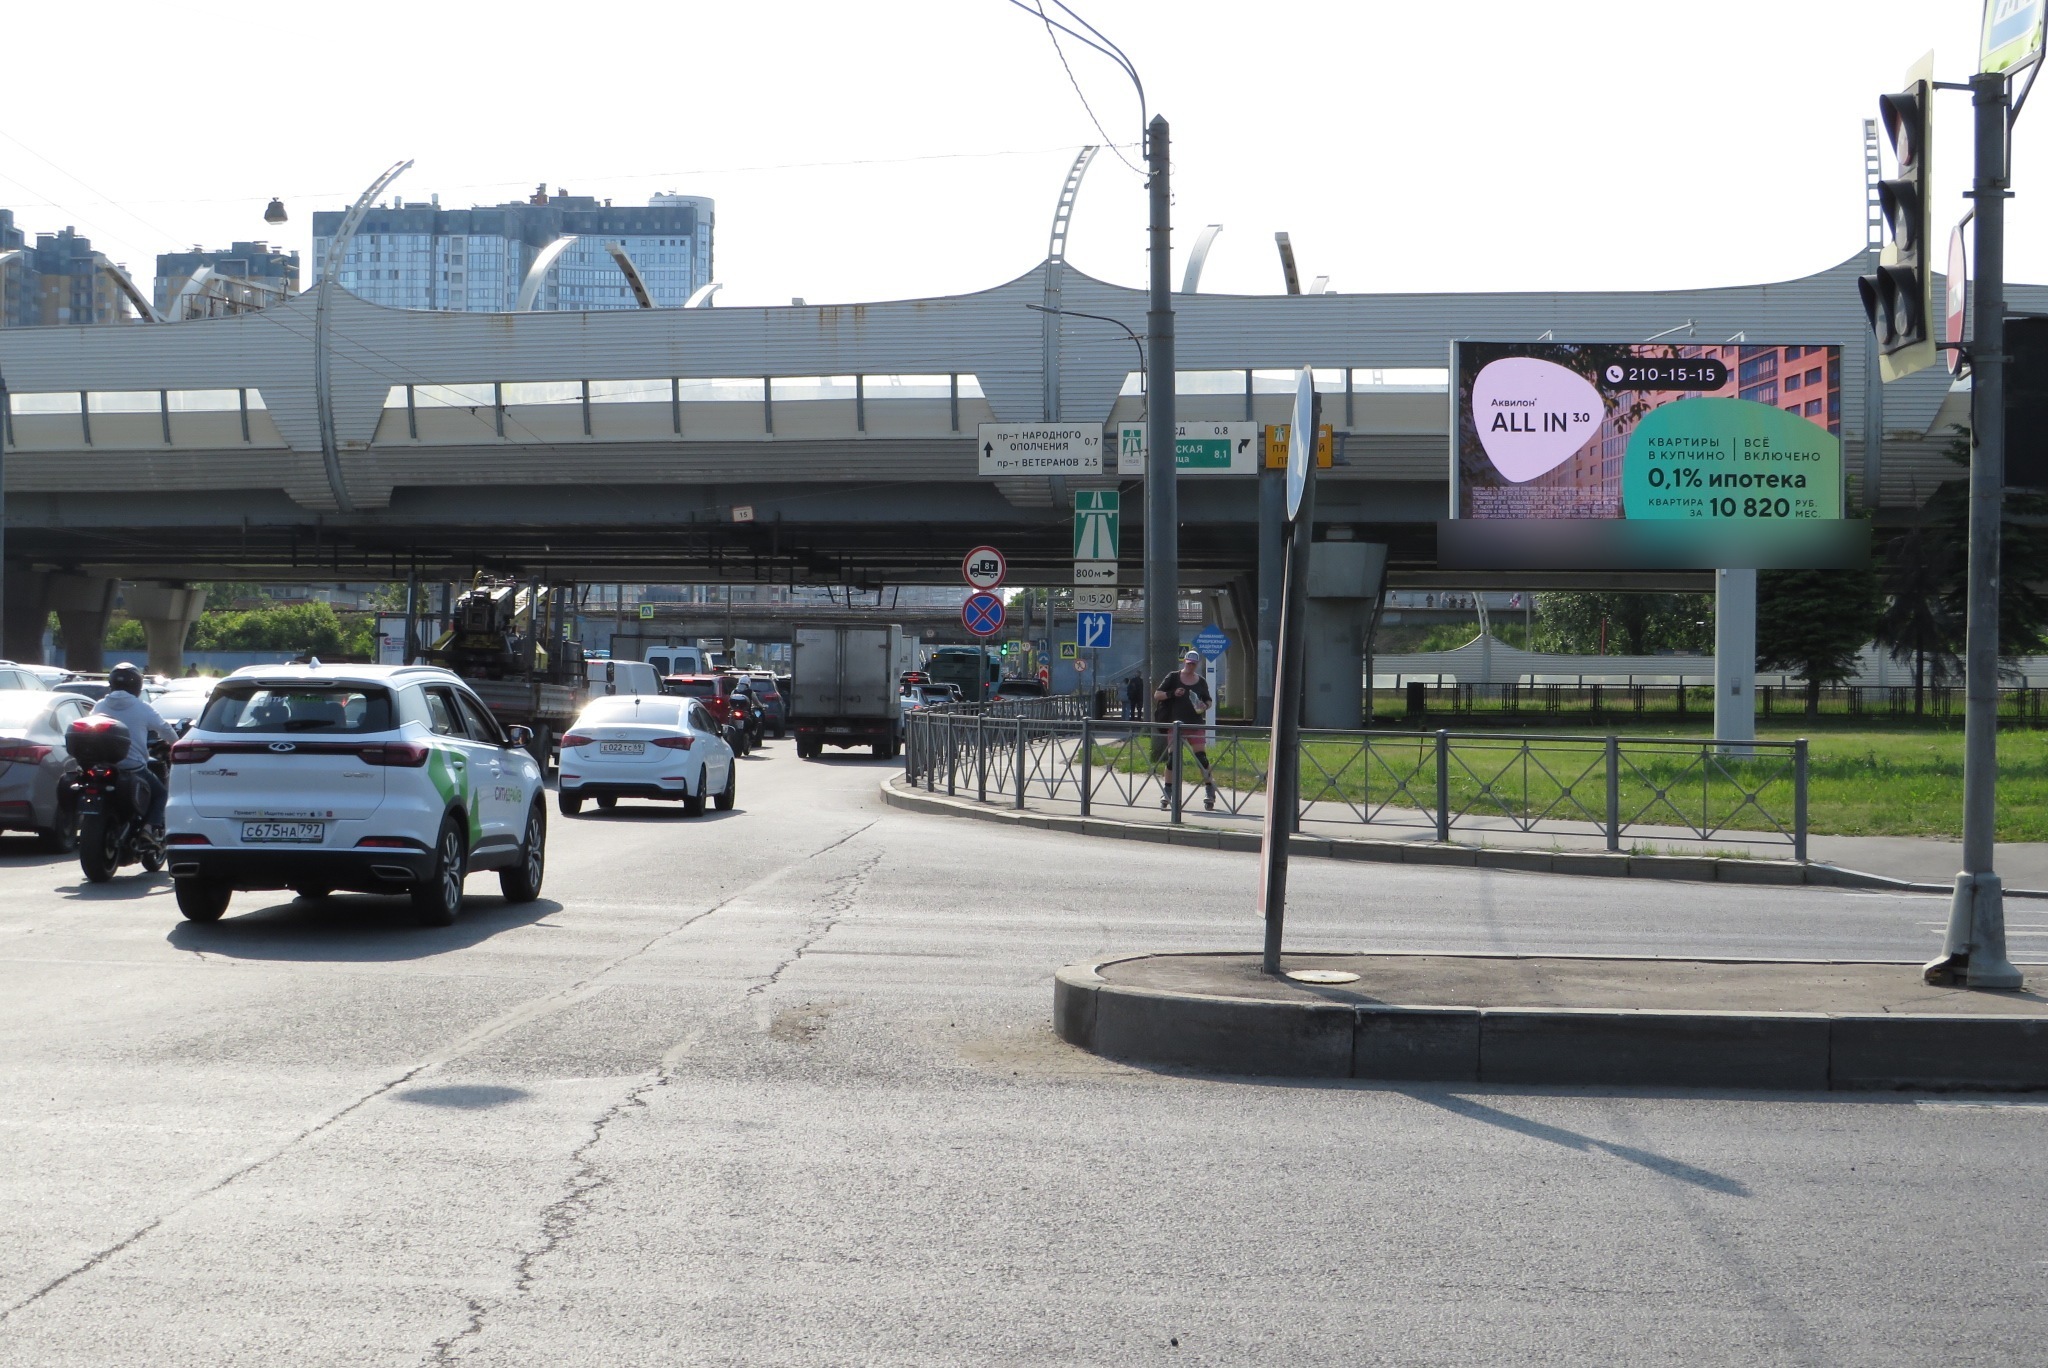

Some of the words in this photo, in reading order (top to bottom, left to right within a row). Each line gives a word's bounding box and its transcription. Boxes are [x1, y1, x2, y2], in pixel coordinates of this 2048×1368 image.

[1629, 368, 1715, 382] 210-15-15
[1491, 412, 1536, 432] ALL
[1543, 412, 1567, 432] IN
[1573, 412, 1590, 423] 3.0
[997, 433, 1019, 441] пр-т
[1022, 431, 1081, 440] НАРОДНОГО
[1010, 443, 1069, 451] ОПОЛЧЕНИЯ
[1648, 438, 1720, 447] КВАРТИРЫ
[1744, 436, 1770, 448] ВСЁ
[1648, 451, 1656, 460] В
[1660, 451, 1725, 461] КУПЧИНО
[1744, 452, 1821, 461] ВКЛЮЧЕНО
[997, 460, 1019, 469] пр-т
[1022, 459, 1079, 467] ВЕТЕРАНОВ
[1648, 468, 1702, 490] 0,1%
[1709, 473, 1806, 488] ипотека
[1710, 498, 1736, 517] 10
[1743, 498, 1790, 518] 820
[1795, 510, 1821, 518] МЕС.
[985, 562, 995, 570] 8т
[1089, 595, 1097, 603] 15
[1099, 594, 1113, 603] 20
[246, 824, 297, 837] С675НА
[300, 824, 320, 834] 797
